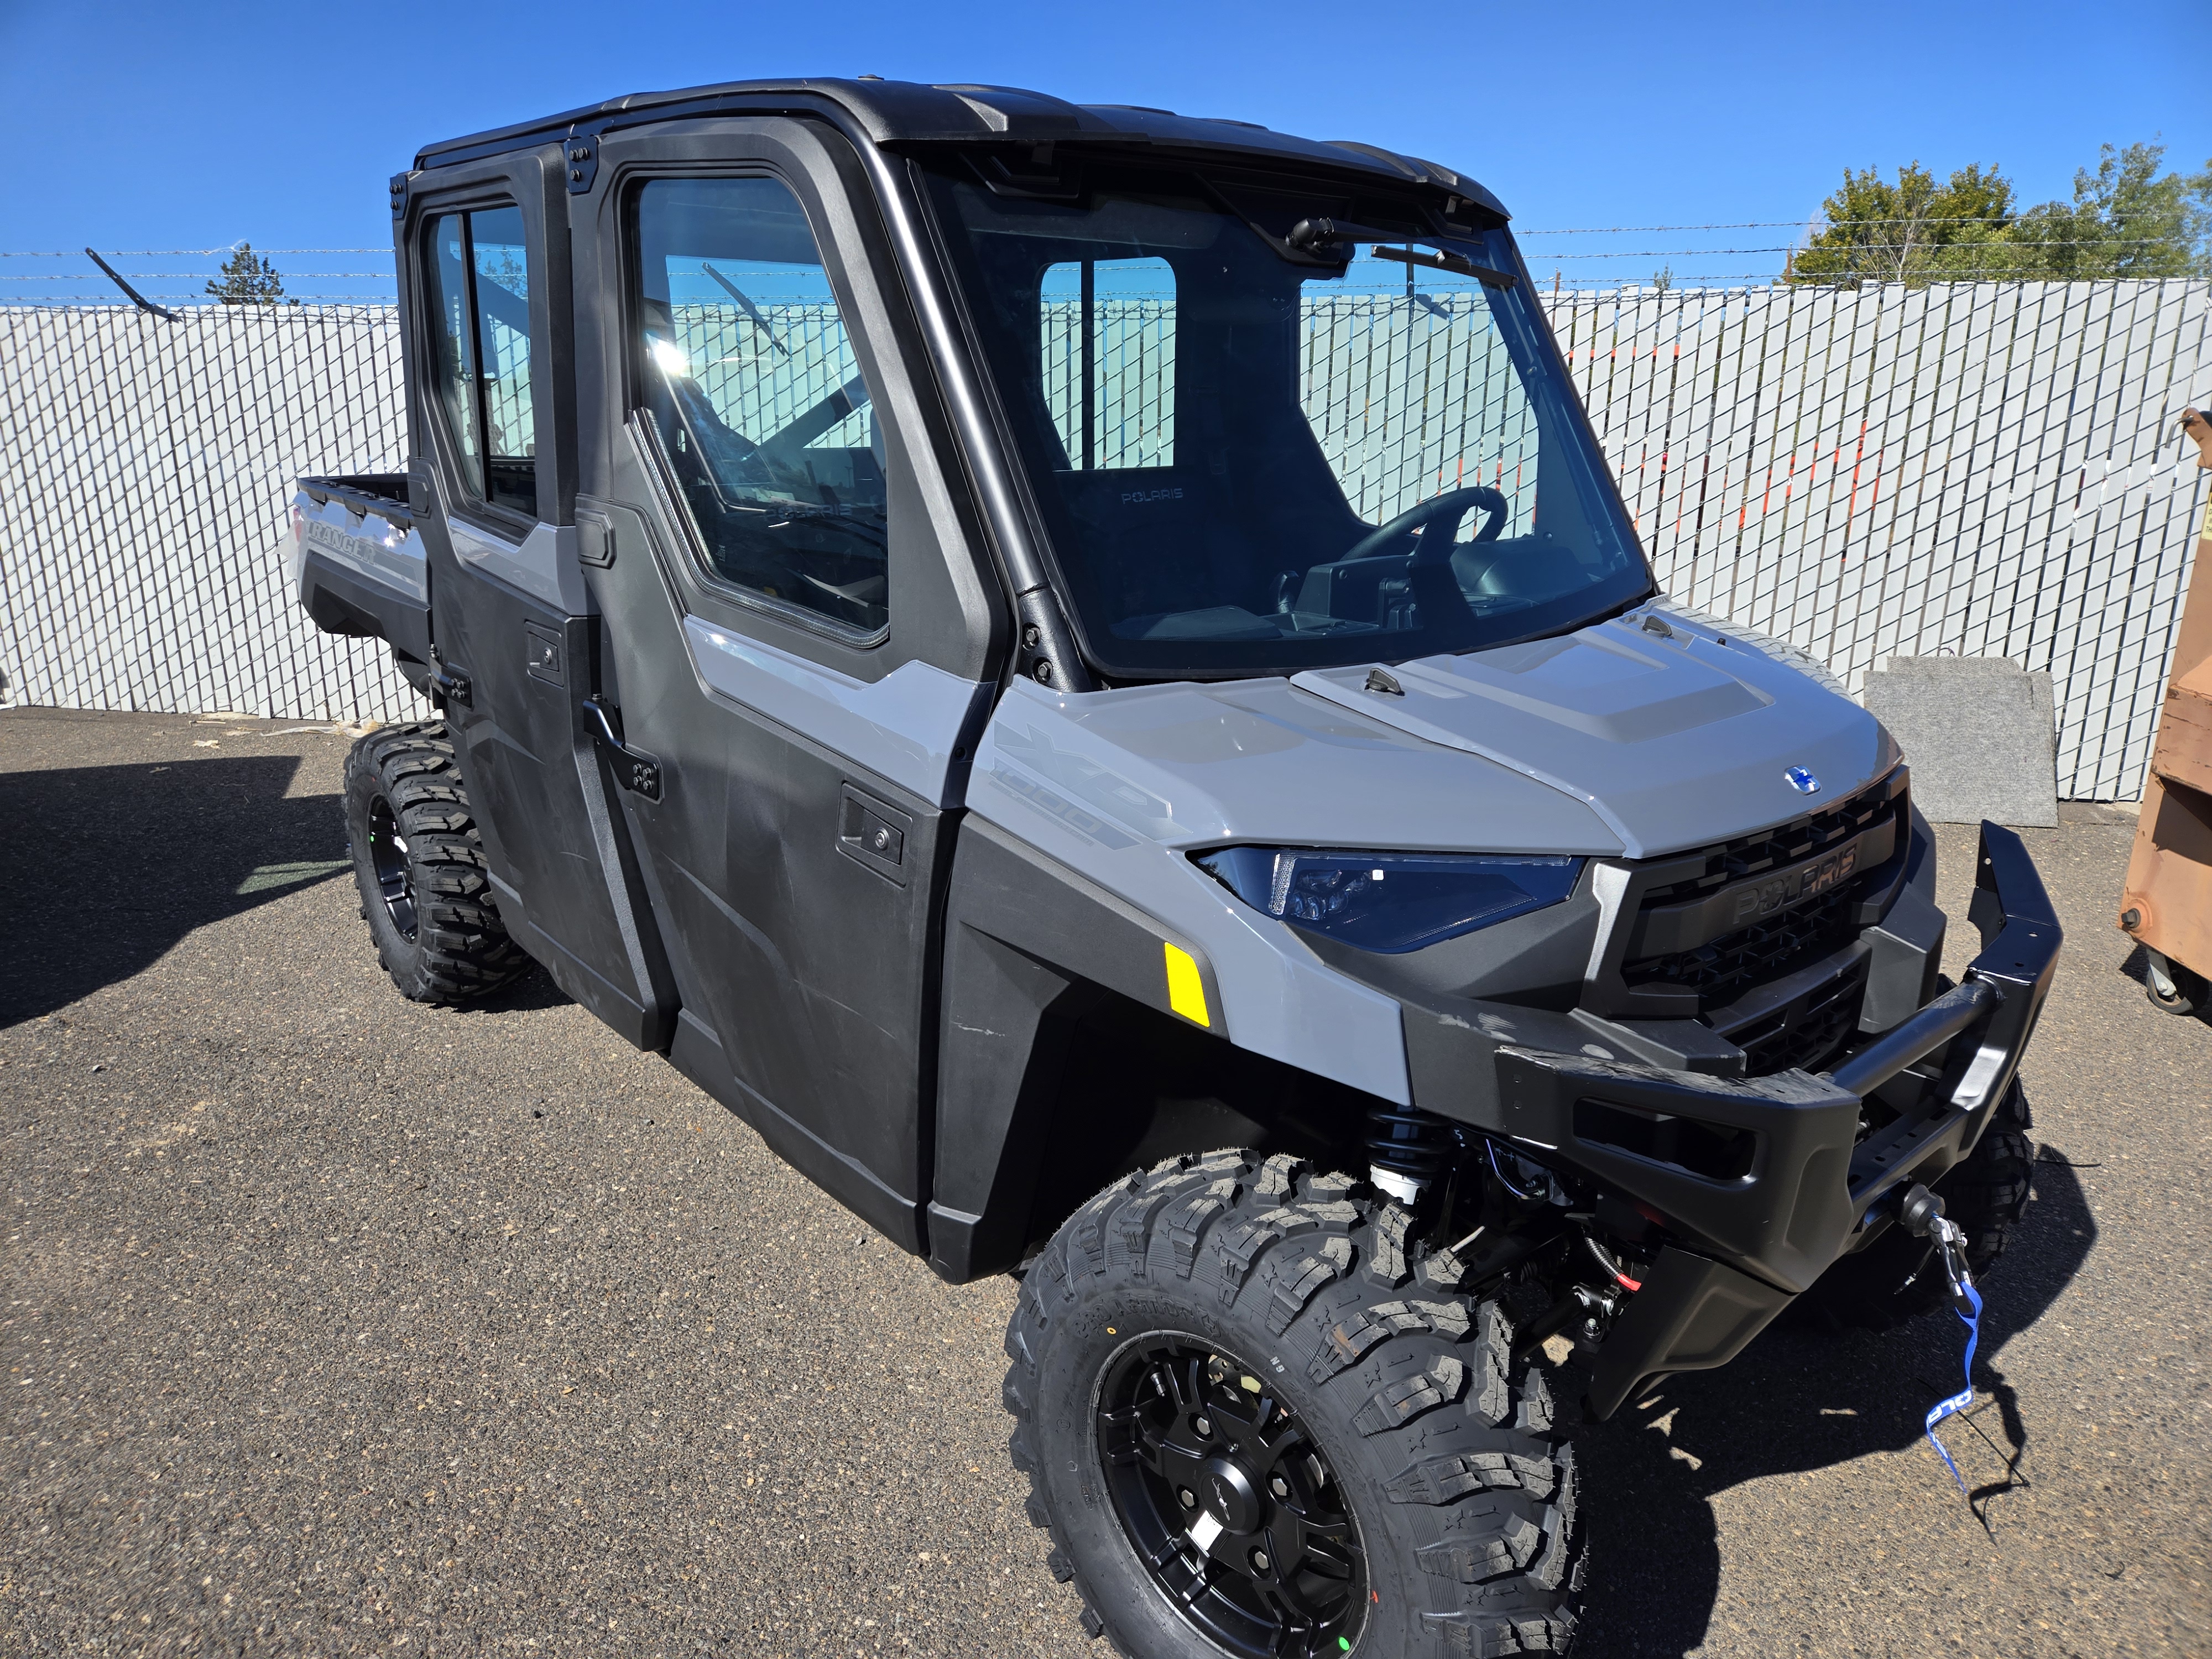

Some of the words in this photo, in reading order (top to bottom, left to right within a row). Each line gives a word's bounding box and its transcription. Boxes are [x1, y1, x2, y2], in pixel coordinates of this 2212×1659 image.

[1121, 488, 1183, 504] POLARIS
[311, 521, 377, 565] RANGER
[990, 760, 1103, 833] 1000
[995, 720, 1178, 836] XP
[1733, 843, 1858, 925] POLARIS
